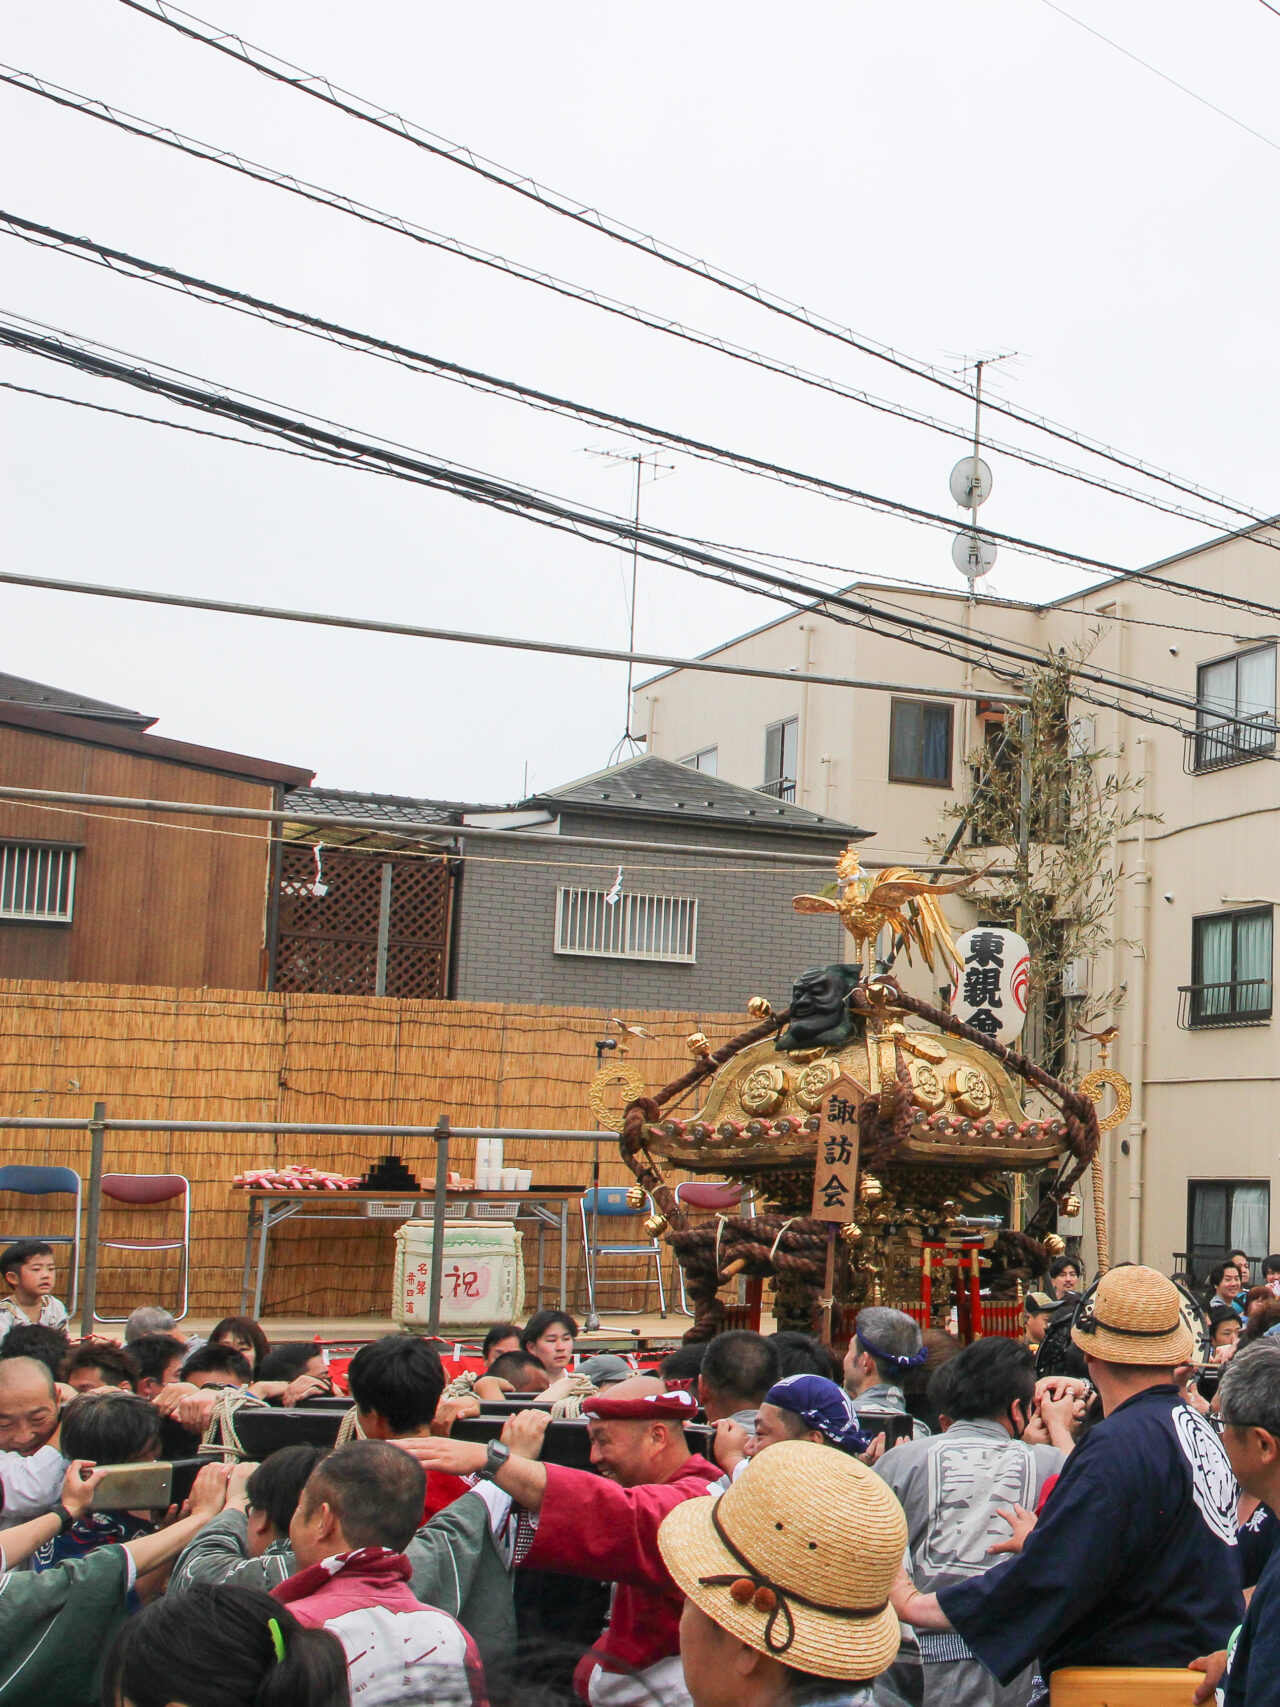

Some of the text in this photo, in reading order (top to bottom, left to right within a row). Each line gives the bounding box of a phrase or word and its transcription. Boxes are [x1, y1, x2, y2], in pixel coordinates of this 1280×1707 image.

[819, 1094, 857, 1207] 諏訪会
[444, 1265, 480, 1298] 祝
